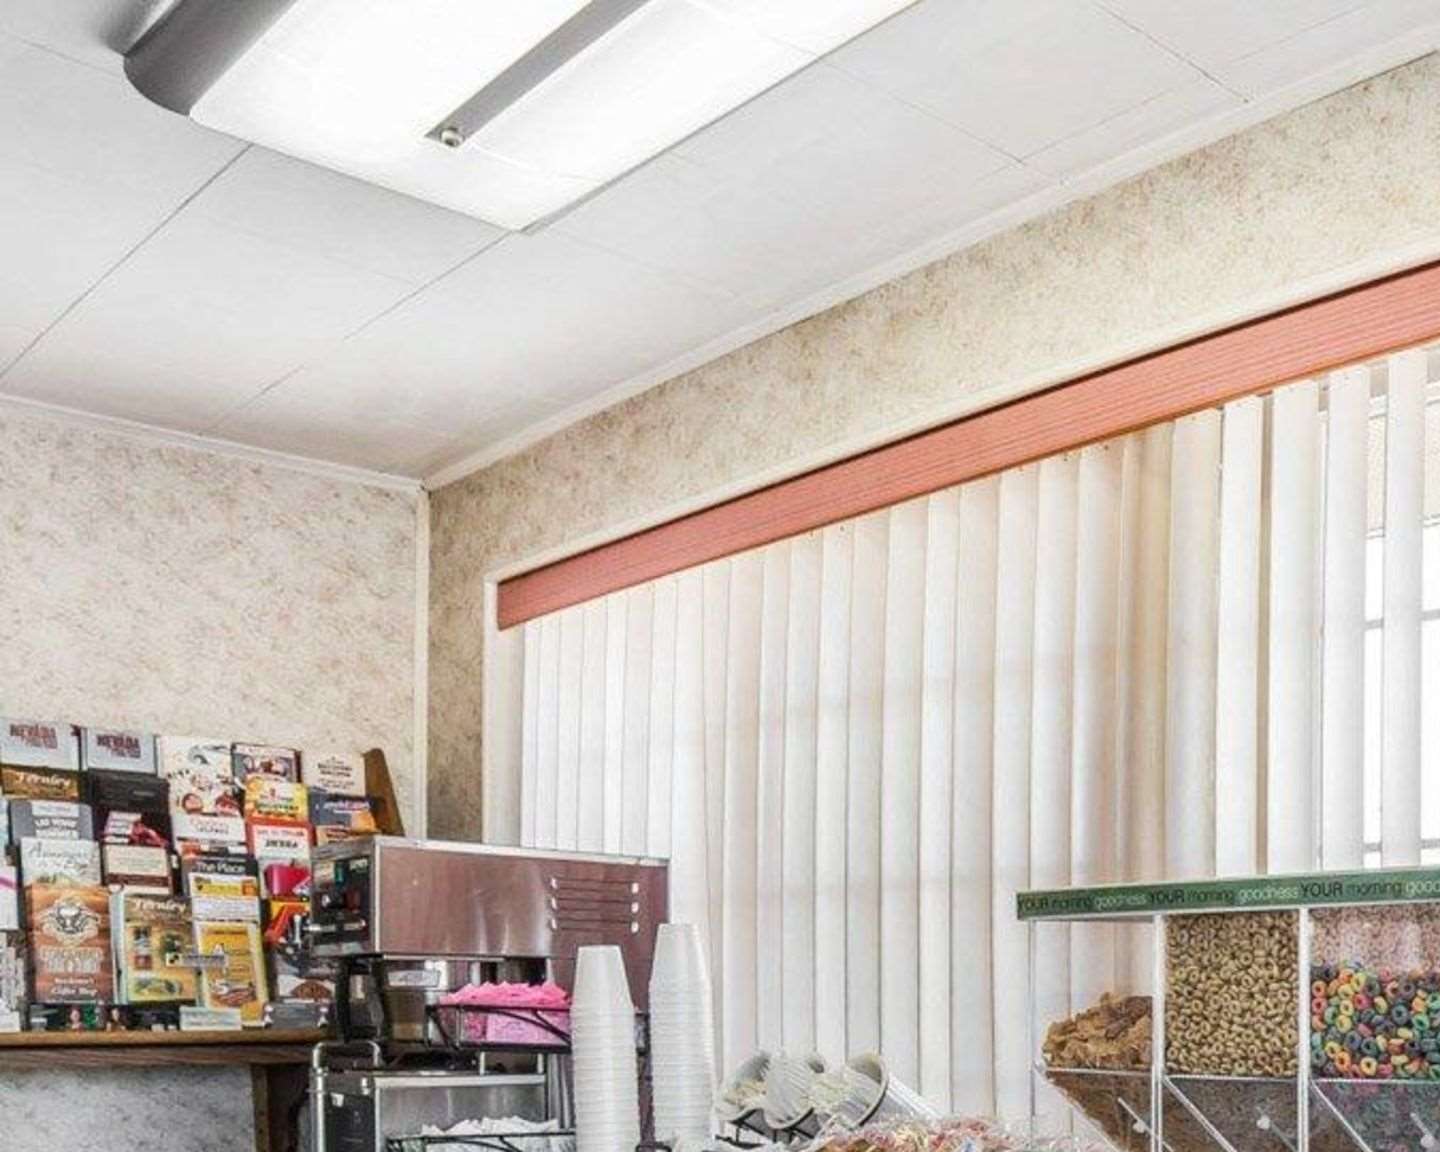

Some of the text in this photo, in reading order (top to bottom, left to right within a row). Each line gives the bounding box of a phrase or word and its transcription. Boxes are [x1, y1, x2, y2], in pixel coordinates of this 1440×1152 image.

[1149, 888, 1185, 905] YOUR
[1238, 884, 1298, 902] goodness
[1301, 881, 1343, 898] YOUR
[1347, 880, 1401, 900] morning
